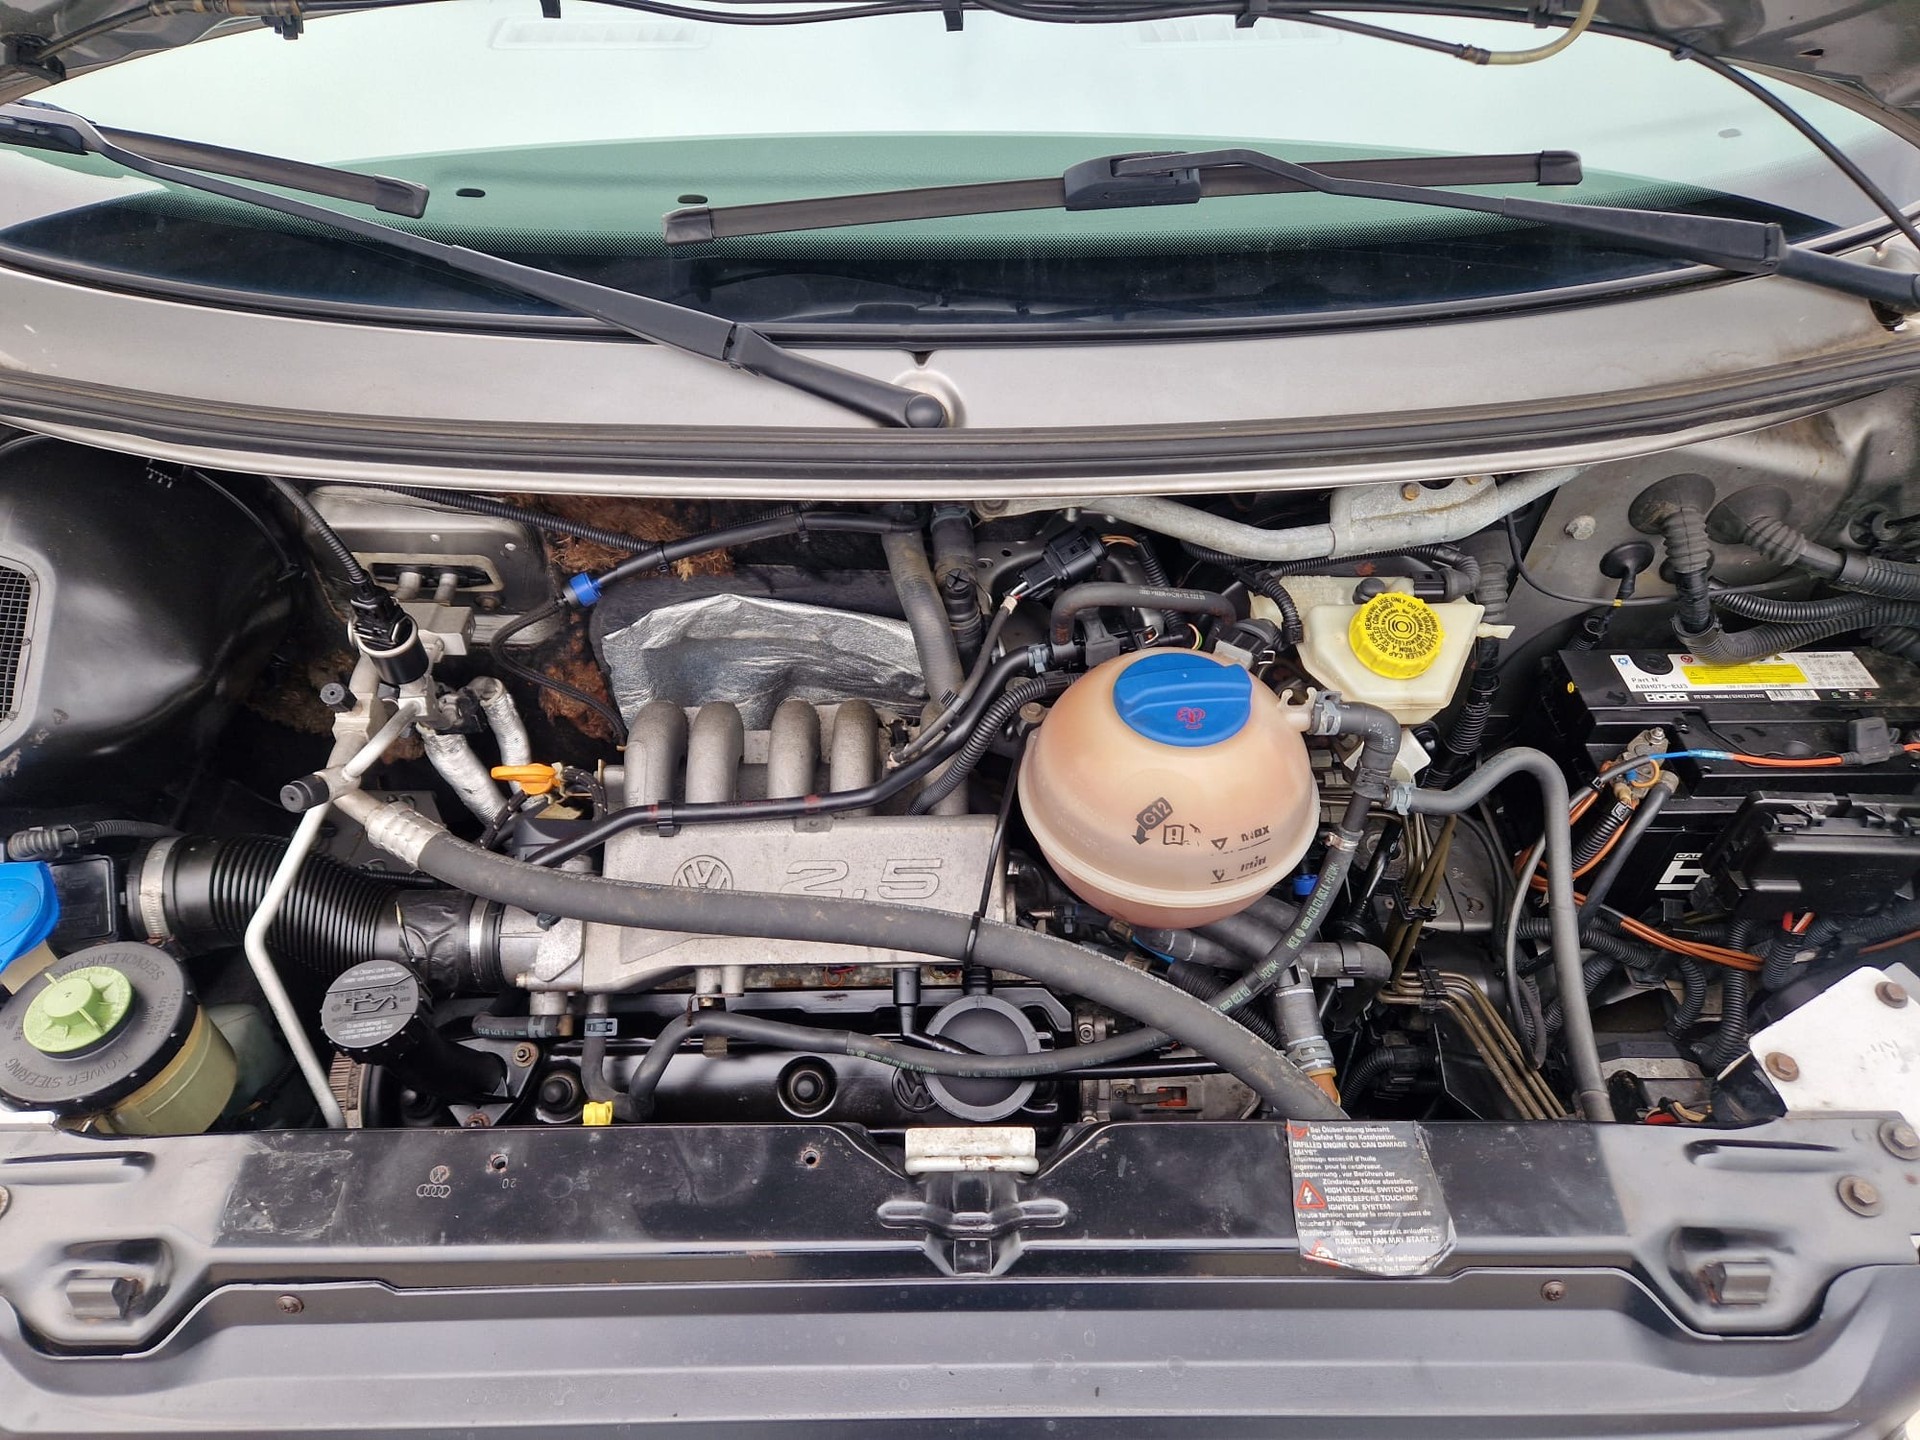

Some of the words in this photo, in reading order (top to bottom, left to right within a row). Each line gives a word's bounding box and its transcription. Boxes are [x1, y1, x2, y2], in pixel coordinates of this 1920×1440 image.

[1377, 597, 1389, 606] USE
[1390, 596, 1406, 604] ONLY
[1407, 602, 1420, 612] DOT
[1142, 801, 1171, 826] G12
[1323, 1141, 1348, 1149] ENGINE
[1348, 1141, 1361, 1149] OIL
[1380, 1194, 1419, 1202] TOUCHING
[1328, 1203, 1359, 1211] IGNITION
[1335, 1237, 1372, 1246] RADIATOR
[1372, 1237, 1387, 1245] FAN
